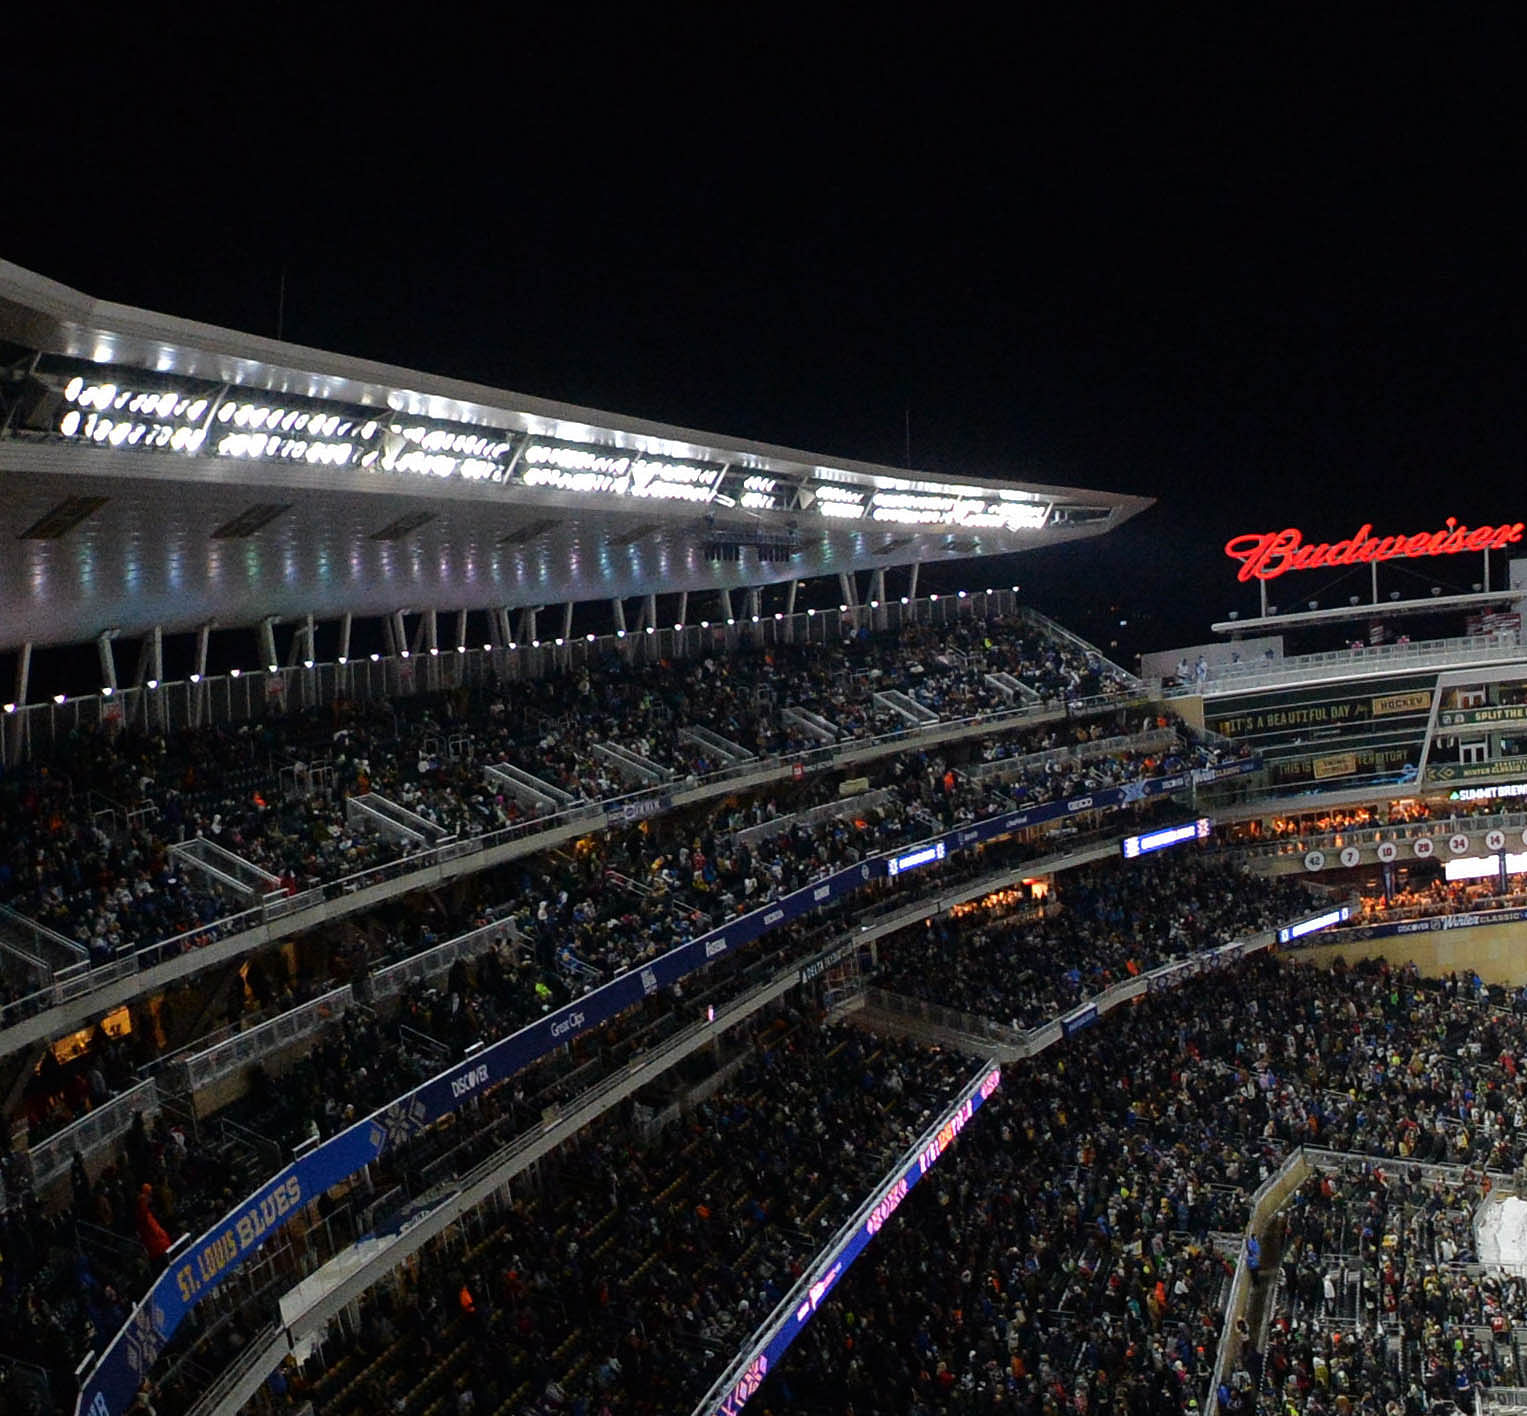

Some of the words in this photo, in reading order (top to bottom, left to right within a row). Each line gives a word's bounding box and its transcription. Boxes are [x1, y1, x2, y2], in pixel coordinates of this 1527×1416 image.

[1226, 516, 1525, 583] Budweiser
[1229, 718, 1252, 732] IT'S
[1257, 717, 1264, 728] A
[1267, 706, 1328, 727] BEAUTIFUL
[1331, 705, 1350, 719] DAY
[1476, 709, 1501, 721] SPLIT
[1505, 708, 1523, 719] THE
[1459, 786, 1497, 801] SUMMIT
[1398, 922, 1429, 933] DISCOVER
[1442, 914, 1480, 930] Winter
[1480, 912, 1519, 925] CLASSIC
[450, 1064, 489, 1098] DISCOVER
[176, 1264, 202, 1304] ST.
[198, 1229, 237, 1281] LOUIS
[237, 1174, 301, 1250] BLUES
